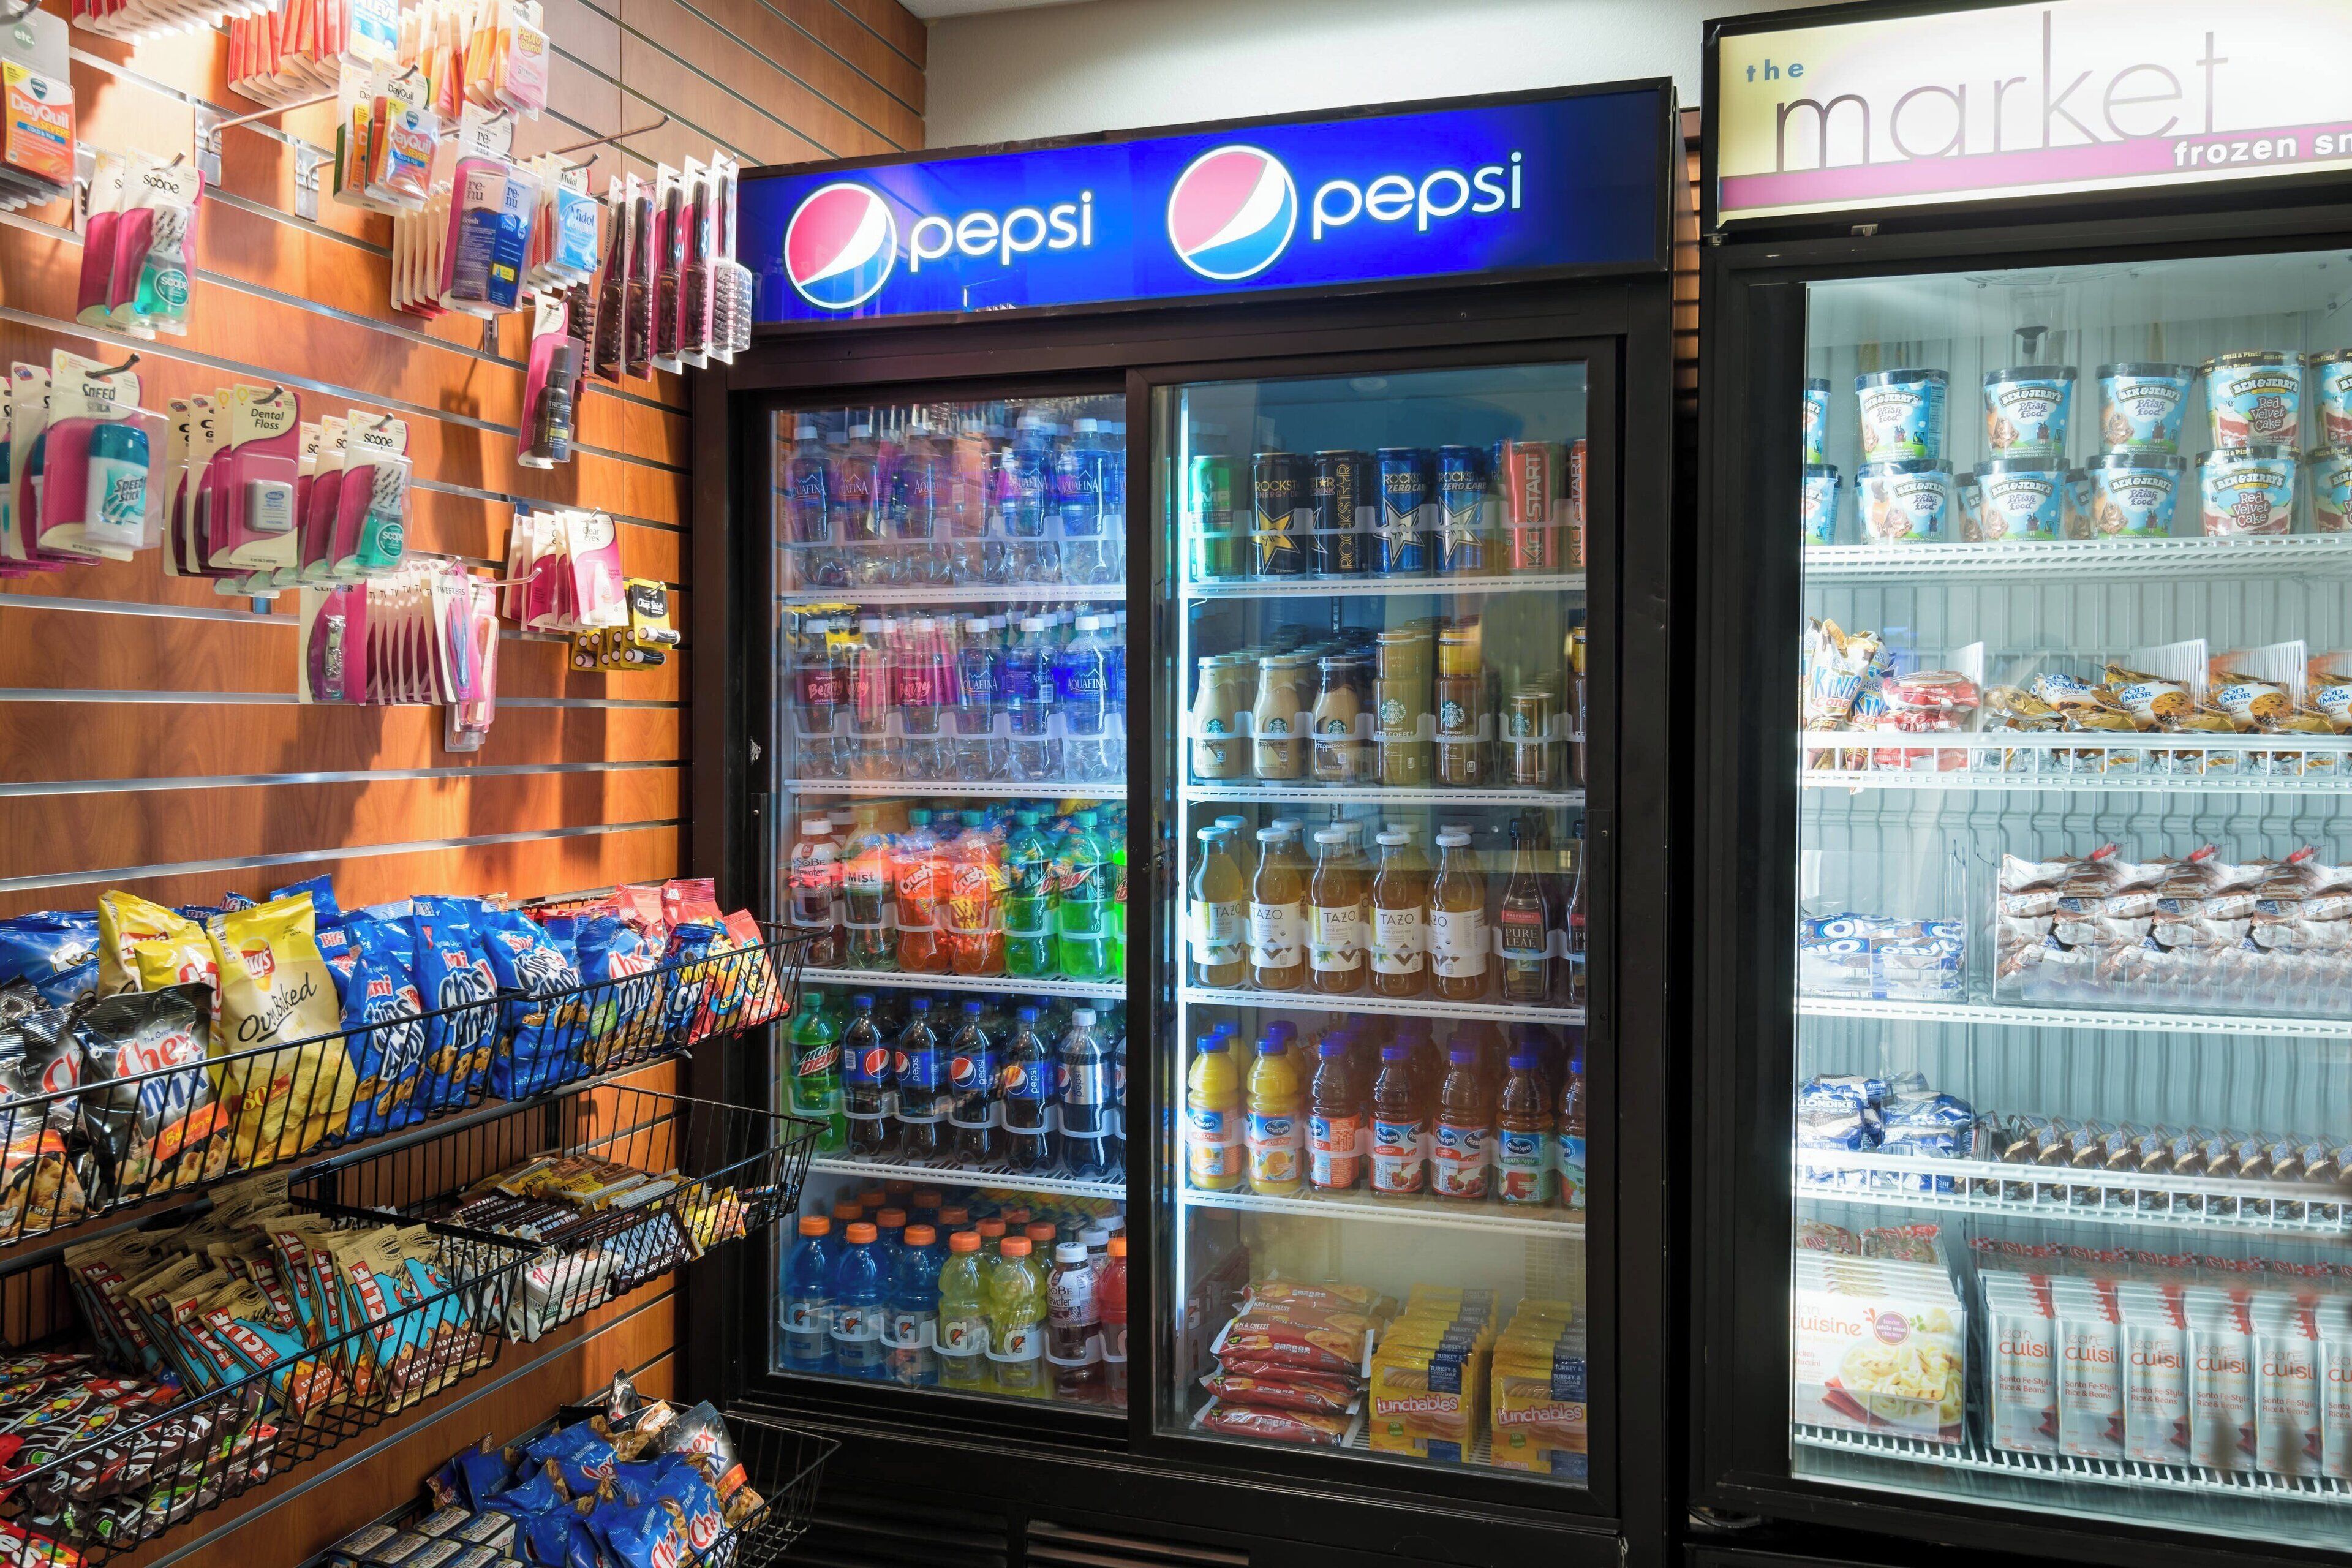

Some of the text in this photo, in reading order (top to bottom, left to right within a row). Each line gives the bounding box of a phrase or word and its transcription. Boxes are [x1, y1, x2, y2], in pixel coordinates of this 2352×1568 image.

[1745, 59, 1804, 83] the
[1775, 10, 2230, 173] market
[10, 92, 70, 129] DayQuil
[2174, 137, 2297, 167] frozen
[143, 173, 180, 195] scope
[1311, 151, 1524, 240] pepsi
[910, 190, 1093, 273] pepsi
[2258, 397, 2281, 409] Red
[250, 408, 285, 421] Dental
[2249, 406, 2285, 420] Velvet
[254, 418, 280, 430] Floss
[2254, 418, 2282, 431] Cake
[364, 433, 393, 450] scope
[1061, 477, 1099, 494] AQUAFINA
[1387, 484, 1411, 493] ZERO
[1442, 482, 1466, 491] ZERO
[2239, 492, 2264, 503] Red
[1521, 453, 1543, 568] KICKSTART
[2232, 502, 2269, 515] Velvet
[2236, 513, 2267, 527] Cake
[807, 680, 844, 699] Berry
[960, 676, 998, 692] AQUAFINA
[1066, 676, 1108, 692] AQUAFINA
[1813, 666, 1862, 700] KING
[899, 864, 933, 895] Crush
[952, 866, 989, 896] Crush
[1213, 903, 1242, 918] TAZO
[1251, 907, 1283, 920] TAZO
[1323, 910, 1356, 924] TAZO
[1379, 913, 1415, 925] TAZO
[318, 931, 346, 948] BIG
[1505, 928, 1537, 938] PURE
[1505, 937, 1536, 948] LEAF
[911, 1055, 921, 1082] pepsi
[976, 1058, 987, 1085] pepsi
[1028, 1068, 1039, 1094] pepsi
[1074, 1071, 1084, 1098] pepsi
[1204, 1120, 1215, 1128] Spray
[1266, 1125, 1290, 1134] Ocean Spray
[1444, 1136, 1456, 1144] Spray
[1520, 1142, 1532, 1151] Spray
[351, 1266, 389, 1321] CLIF
[1270, 1304, 1291, 1313] CHEESE
[210, 1311, 264, 1352] CLIF
[1999, 1324, 2033, 1340] lean
[2064, 1330, 2098, 1345] lean
[2130, 1335, 2164, 1351] lean
[254, 1347, 275, 1363] BAR
[1999, 1374, 2052, 1387] Santa Fe-Style
[1999, 1382, 2015, 1391] Rice
[2022, 1385, 2046, 1394] Beans
[2065, 1380, 2119, 1392] Santa Fe-Style
[2089, 1390, 2112, 1400] Beans
[2131, 1385, 2185, 1398] Santa Fe-Style
[2220, 1393, 2250, 1404] Fe-Style
[1376, 1394, 1460, 1415] Lunchables
[2154, 1396, 2178, 1405] Beans
[2220, 1402, 2244, 1411] Beans
[1496, 1404, 1584, 1426] Lunchables
